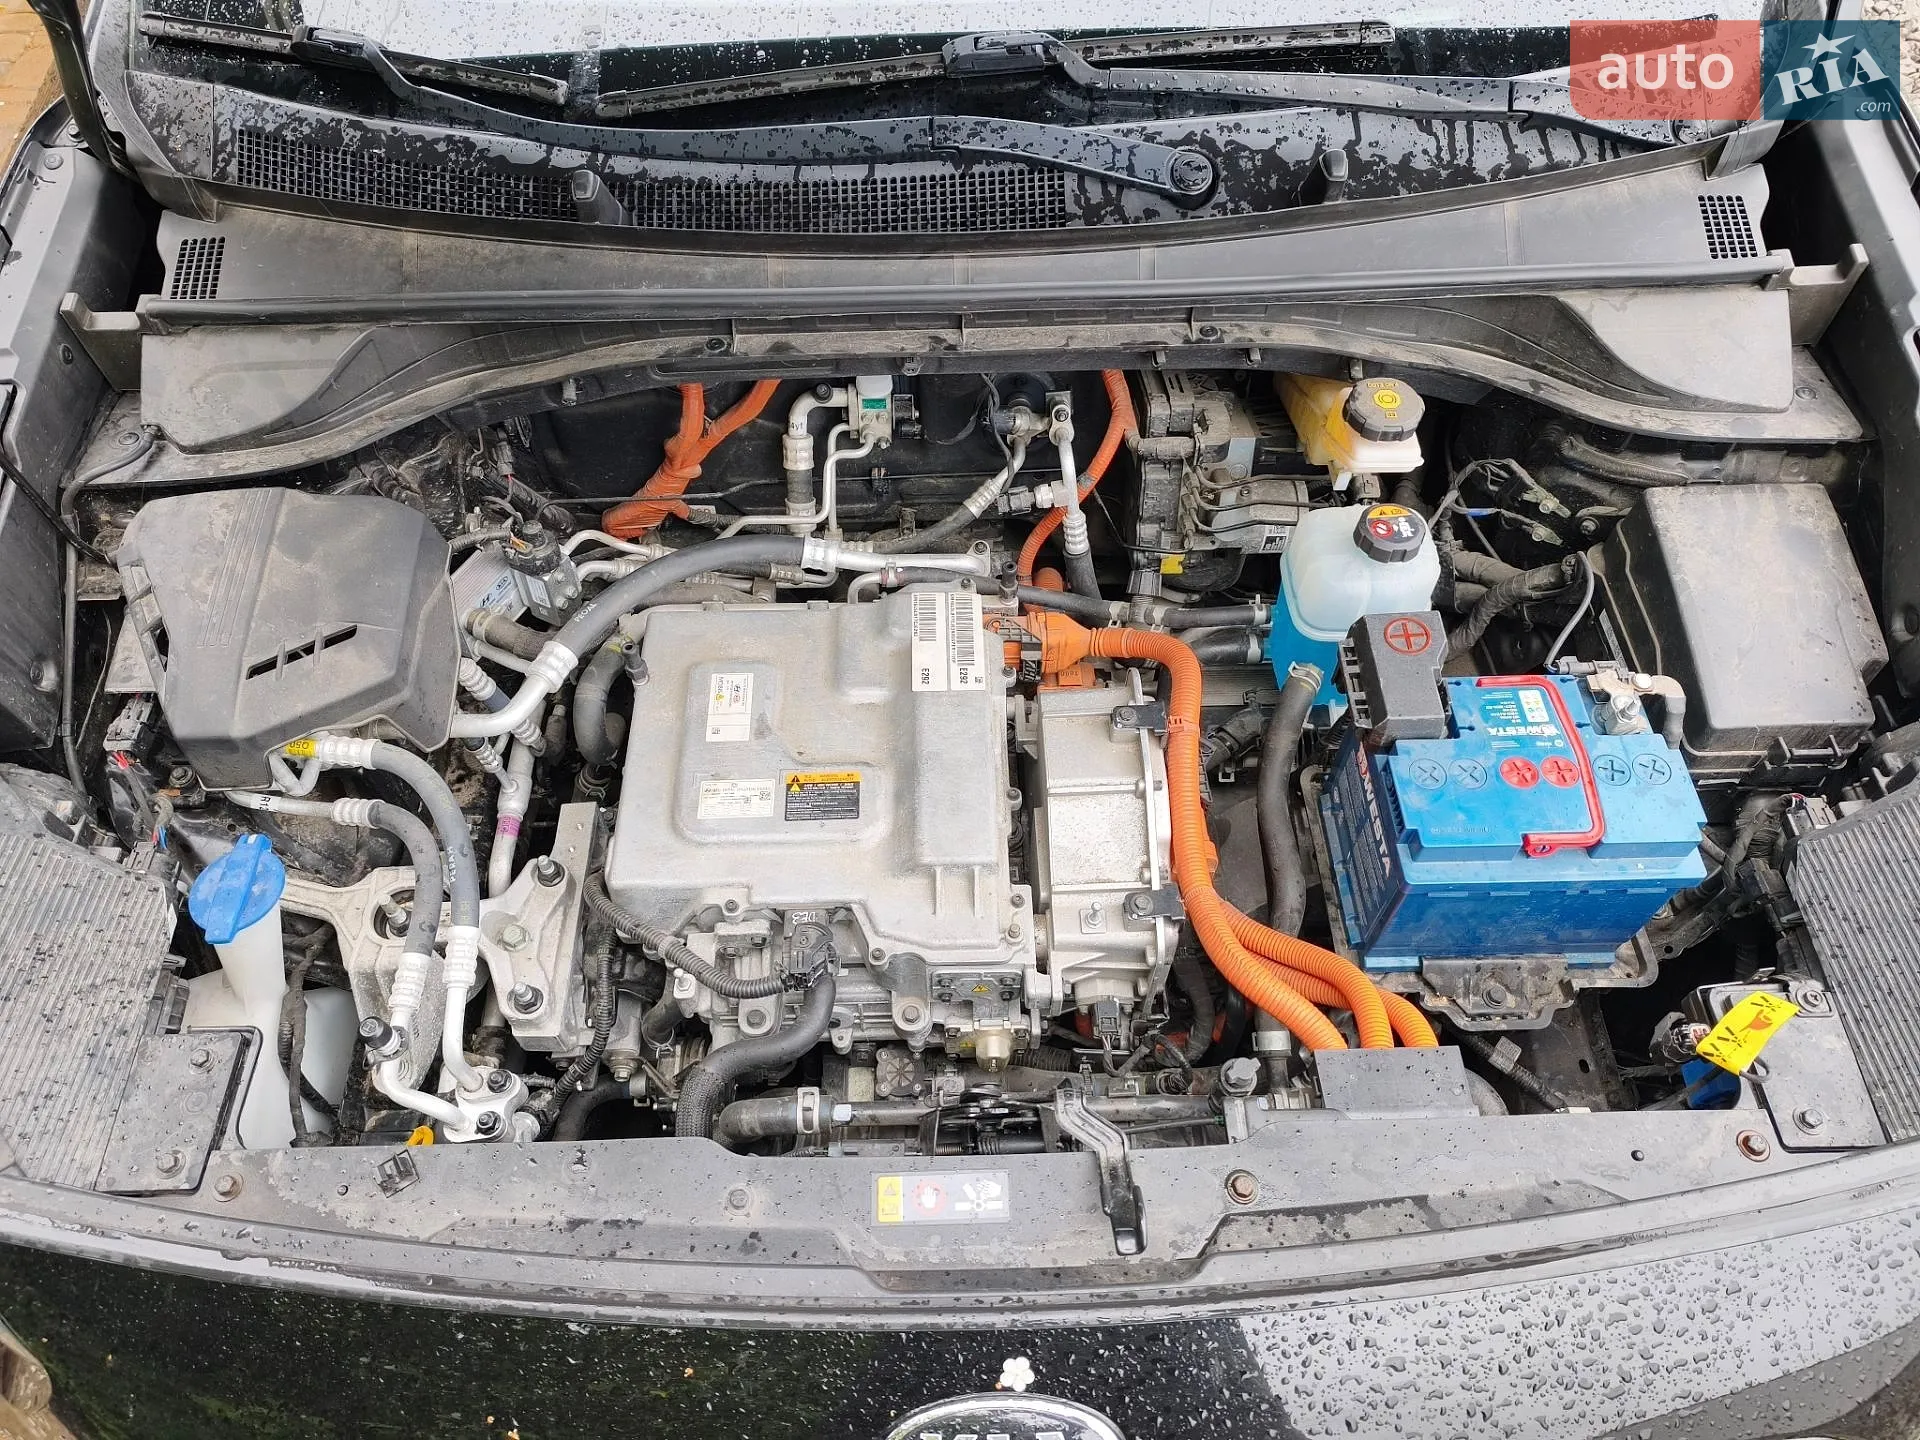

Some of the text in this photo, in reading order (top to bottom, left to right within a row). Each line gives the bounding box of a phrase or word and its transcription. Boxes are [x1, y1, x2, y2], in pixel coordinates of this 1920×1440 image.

[921, 667, 930, 685] E292
[959, 667, 968, 685] E292
[1363, 771, 1391, 878] WESTA
